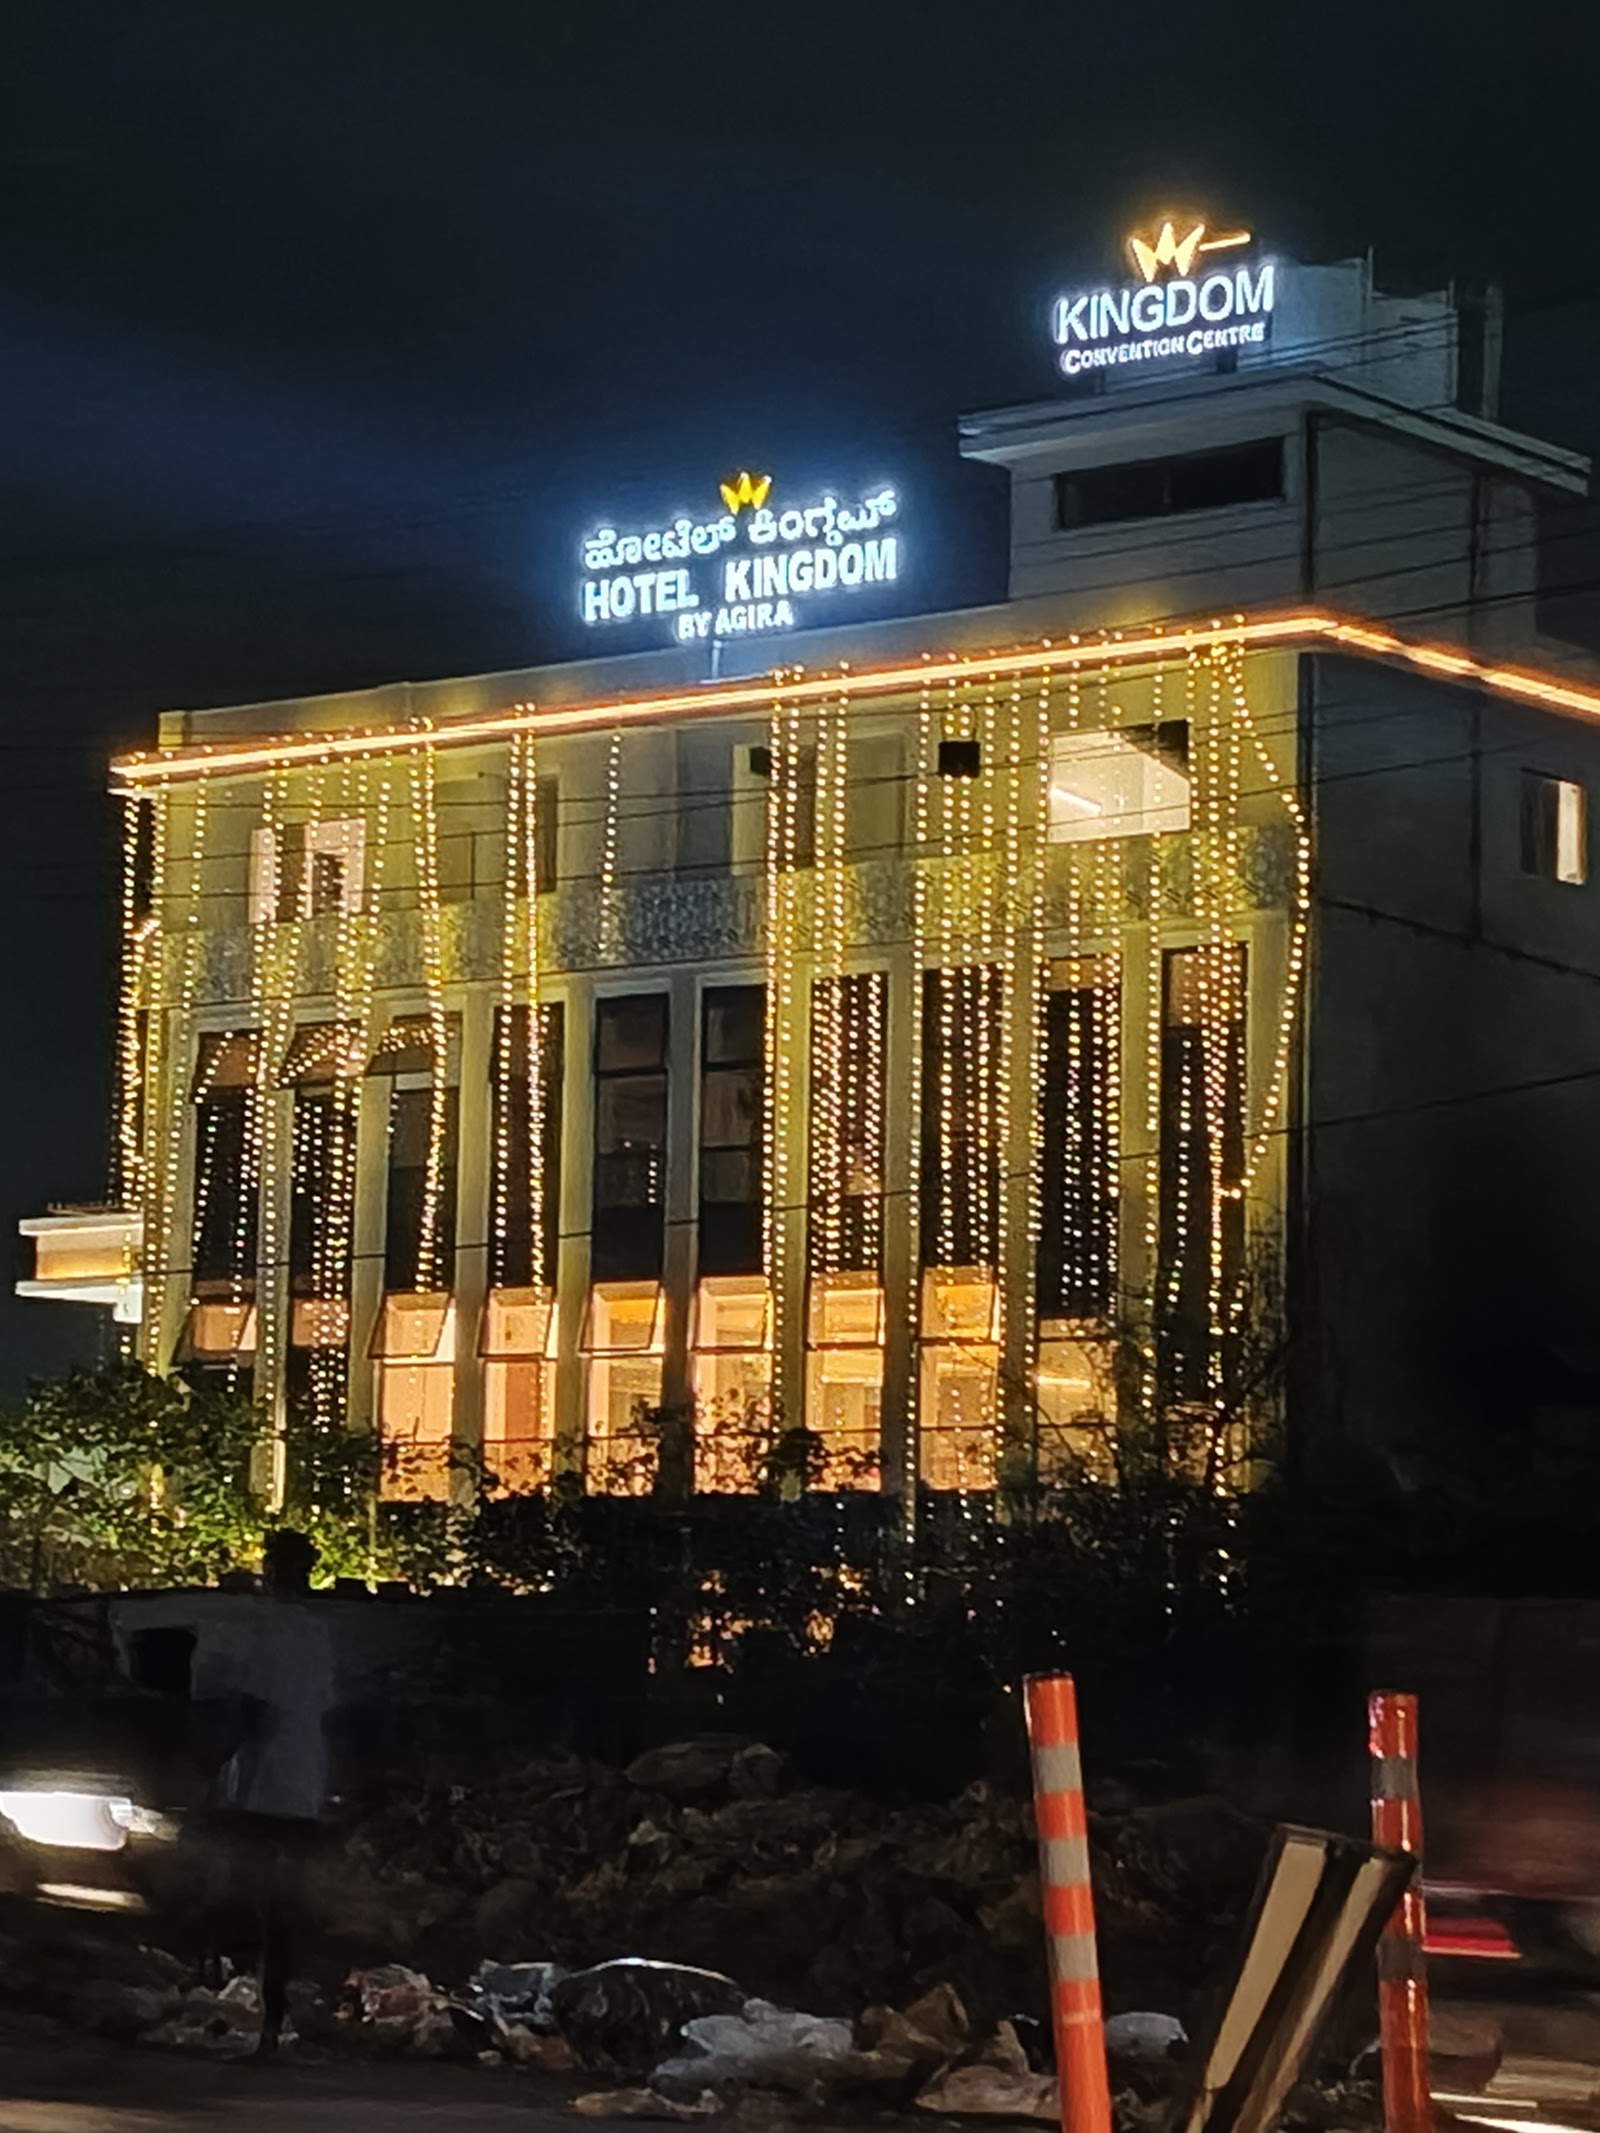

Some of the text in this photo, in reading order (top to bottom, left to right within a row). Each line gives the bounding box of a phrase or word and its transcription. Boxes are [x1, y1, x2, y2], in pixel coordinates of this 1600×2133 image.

[1055, 265, 1275, 344] KINGDOM
[583, 537, 898, 622] HOTEL KINGDOM
[677, 600, 794, 640] BY AGIRA
